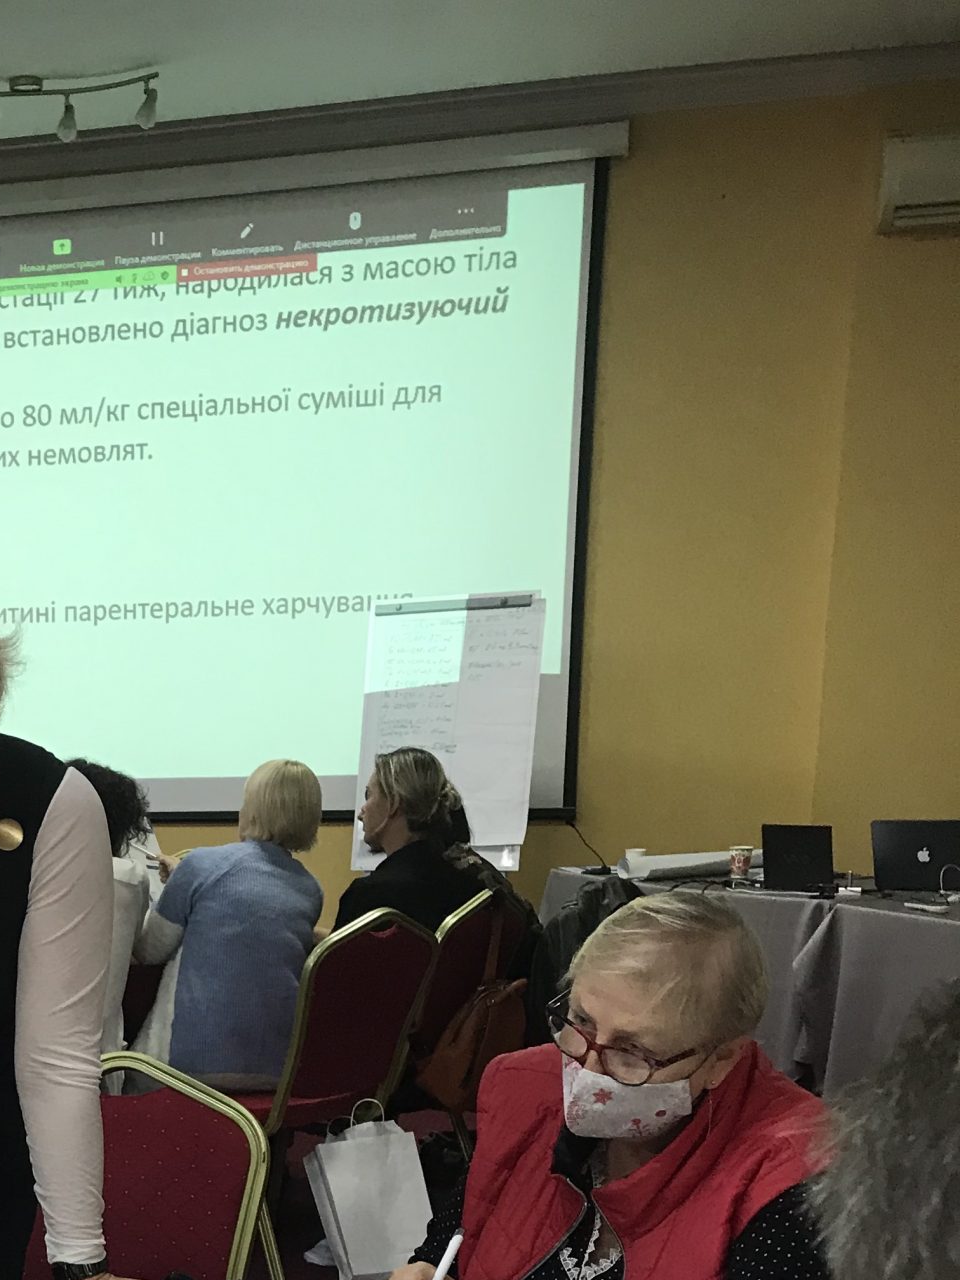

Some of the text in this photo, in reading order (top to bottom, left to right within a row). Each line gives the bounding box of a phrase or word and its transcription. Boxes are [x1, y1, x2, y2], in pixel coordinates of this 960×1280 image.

[211, 244, 284, 257] Комментировать
[176, 266, 333, 299] народилася
[341, 264, 354, 281] з
[363, 256, 456, 281] масою
[464, 246, 518, 271] тіла
[4, 321, 164, 349] встановлено
[171, 308, 268, 343] діагноз
[275, 286, 511, 332] некротизуючий
[22, 403, 53, 427] 80
[59, 397, 130, 425] мл/кг
[137, 387, 291, 422] спеціальної
[297, 382, 386, 415] суміші
[392, 383, 443, 411] для
[26, 439, 153, 467] немовлят.
[64, 595, 255, 627] парентеральне
